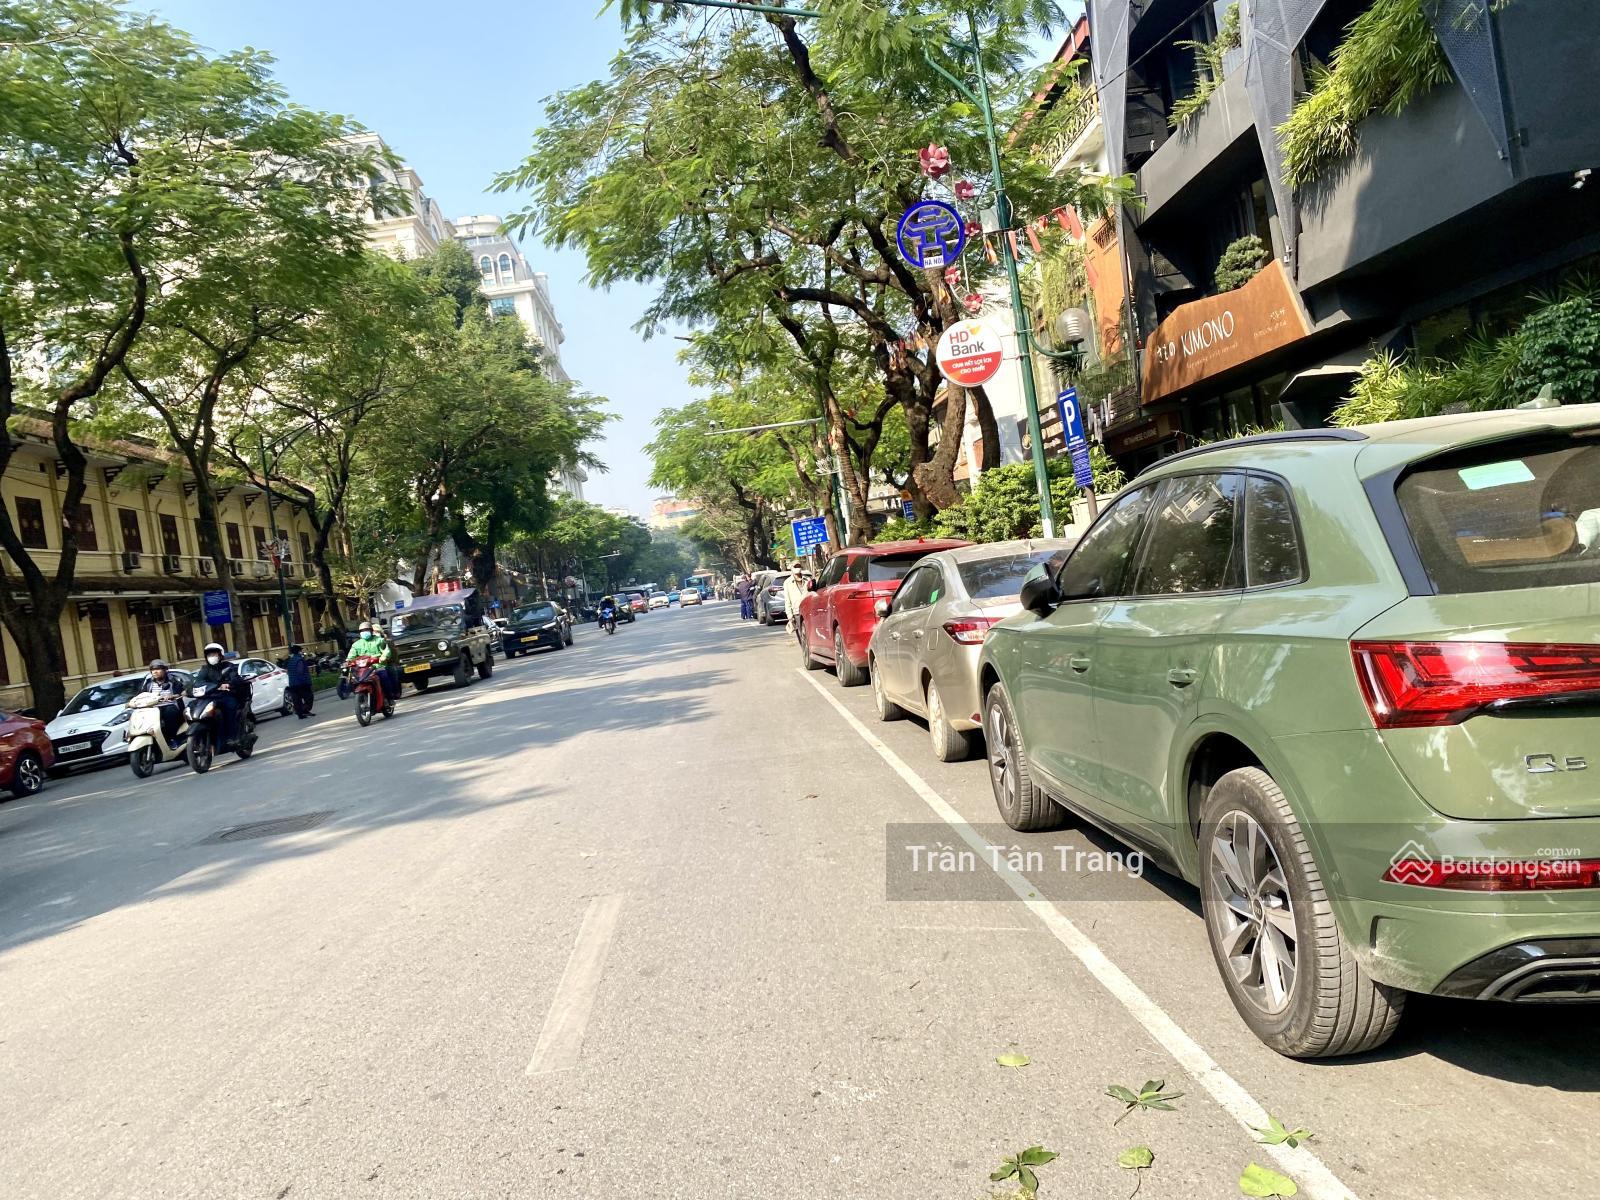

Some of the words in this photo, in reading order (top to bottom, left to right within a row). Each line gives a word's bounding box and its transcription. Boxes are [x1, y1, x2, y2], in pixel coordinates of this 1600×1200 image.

[949, 331, 969, 344] HD
[1180, 310, 1235, 358] KIMONO
[951, 340, 986, 357] Bank
[1063, 399, 1076, 437] P
[1525, 753, 1588, 774] Q5
